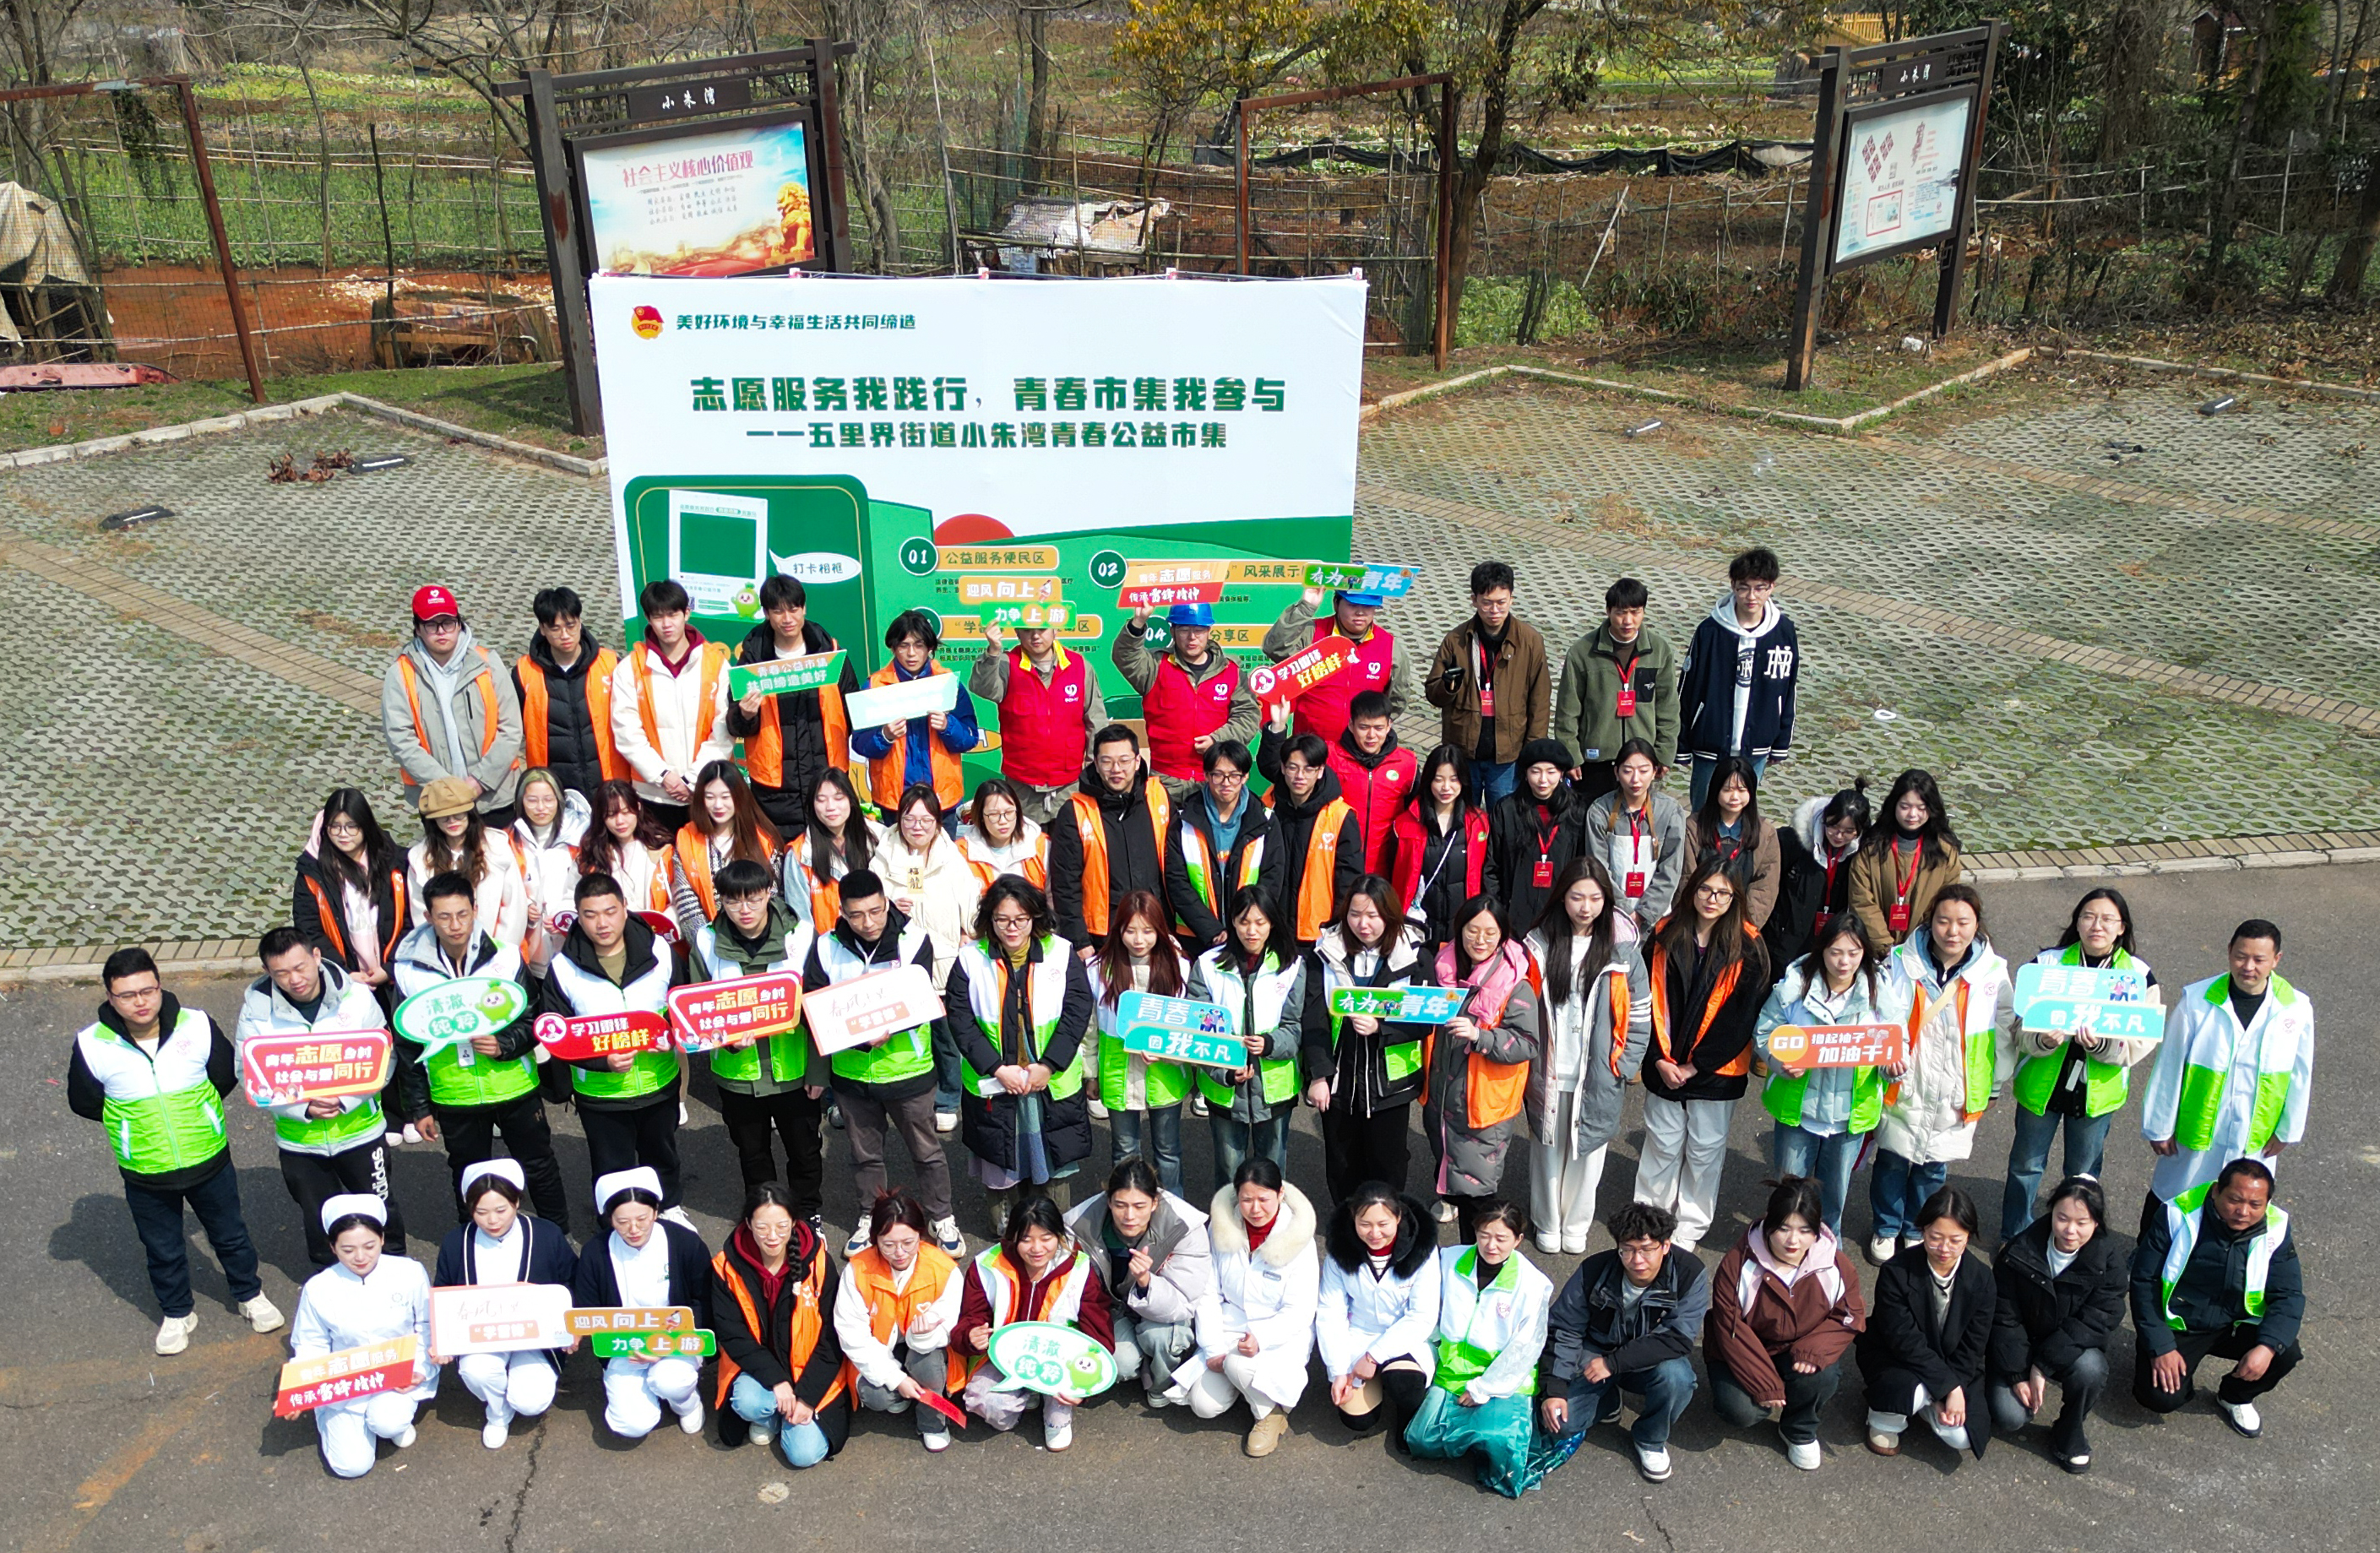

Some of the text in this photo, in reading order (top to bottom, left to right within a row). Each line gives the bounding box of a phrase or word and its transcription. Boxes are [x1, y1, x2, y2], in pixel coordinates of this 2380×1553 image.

[662, 87, 715, 111] 小朱湾
[623, 149, 753, 187] 社会主义核心价值观
[677, 314, 916, 330] 美好环境与幸福生活共同缔造
[909, 549, 927, 565] 01
[945, 551, 1046, 565] 公益服务便民区
[793, 562, 844, 574] 打卡相框
[1098, 562, 1118, 578] 02
[1244, 565, 1304, 578] 风采展示
[966, 581, 1035, 598] 迎风向上
[1310, 567, 1403, 591] 有为 青年
[995, 608, 1066, 622] 力争上游
[1146, 627, 1166, 642] 04
[758, 657, 828, 677] 青春公益市集
[1296, 652, 1342, 688] 好榜样
[747, 670, 828, 692] 共同缔造美好
[2038, 969, 2099, 996] 青春
[688, 986, 785, 1015] 青年志愿乡村
[1137, 996, 1192, 1025] 青春
[1339, 991, 1449, 1018] 有为 青年
[571, 1017, 629, 1036] 学习雷锋
[699, 1002, 789, 1030] 社会与爱同行
[591, 1028, 649, 1052] 好榜样
[1149, 1031, 1231, 1062] 因我不凡
[1773, 1035, 1805, 1050] GO
[265, 1043, 372, 1068] 青年志愿乡村
[274, 1061, 374, 1083] 社会与爱同行
[574, 1312, 660, 1328] 迎风向上
[611, 1337, 701, 1351] 力争上游
